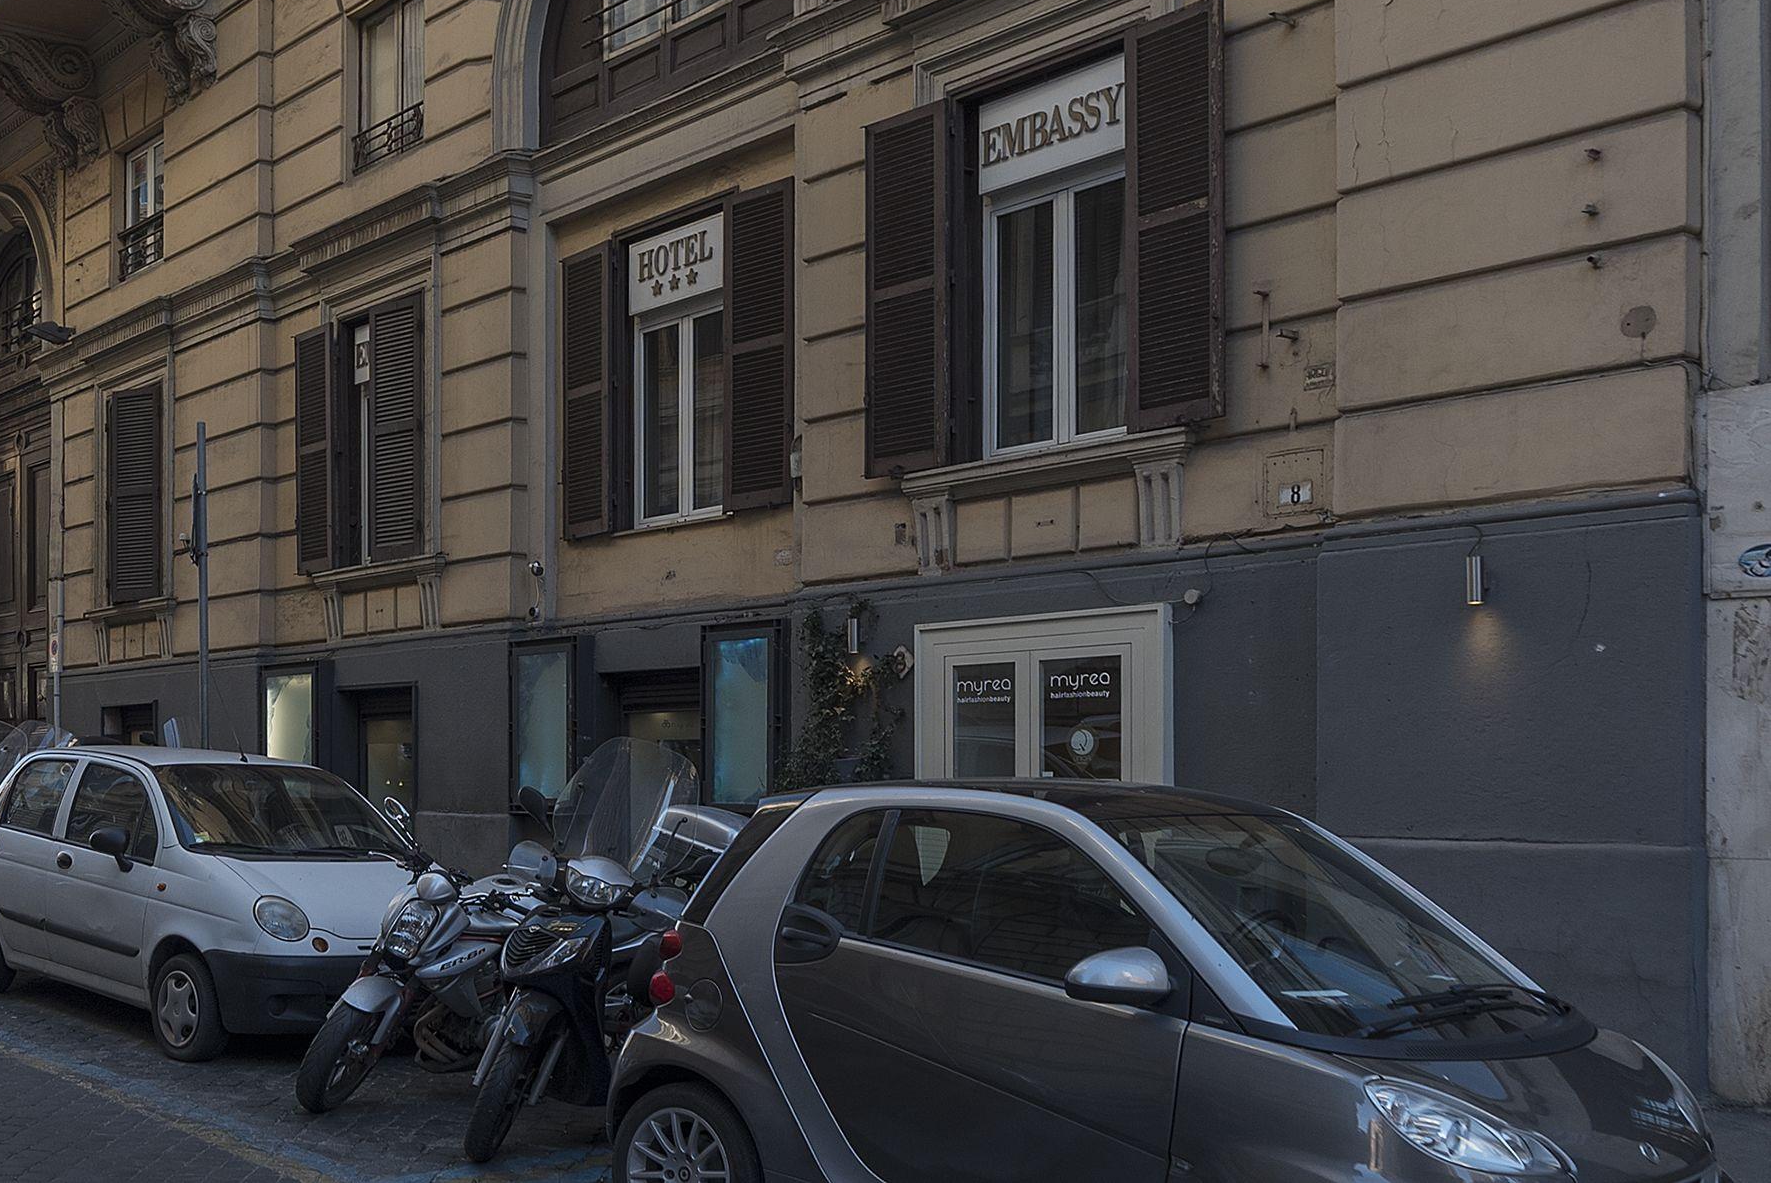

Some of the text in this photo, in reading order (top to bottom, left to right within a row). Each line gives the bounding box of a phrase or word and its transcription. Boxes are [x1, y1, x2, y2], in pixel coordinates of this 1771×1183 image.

[981, 82, 1125, 167] EMBASSY
[637, 230, 713, 283] HOTEL
[1290, 484, 1301, 504] 8
[957, 678, 1012, 695] myrea
[1050, 672, 1111, 690] myrea
